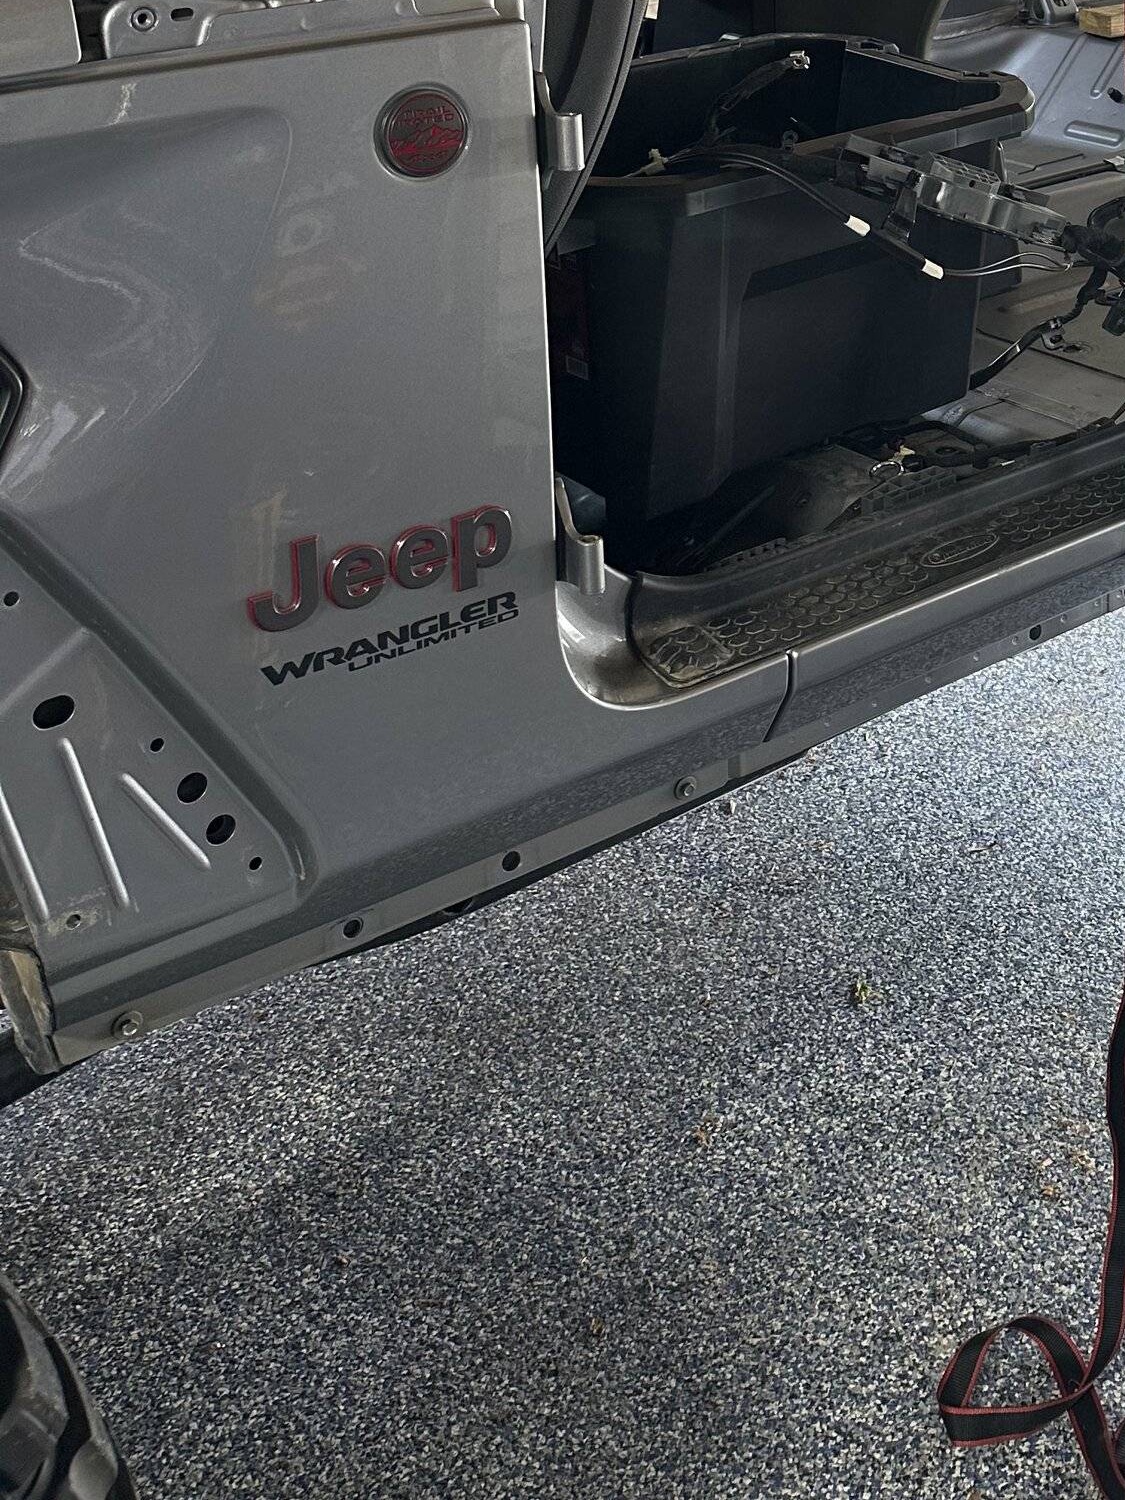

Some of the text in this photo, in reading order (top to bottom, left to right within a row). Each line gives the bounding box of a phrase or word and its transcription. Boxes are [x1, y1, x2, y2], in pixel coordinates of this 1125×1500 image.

[247, 504, 512, 633] Jeep
[260, 591, 519, 686] WRANGLER
[347, 608, 519, 672] UNLIMITED
